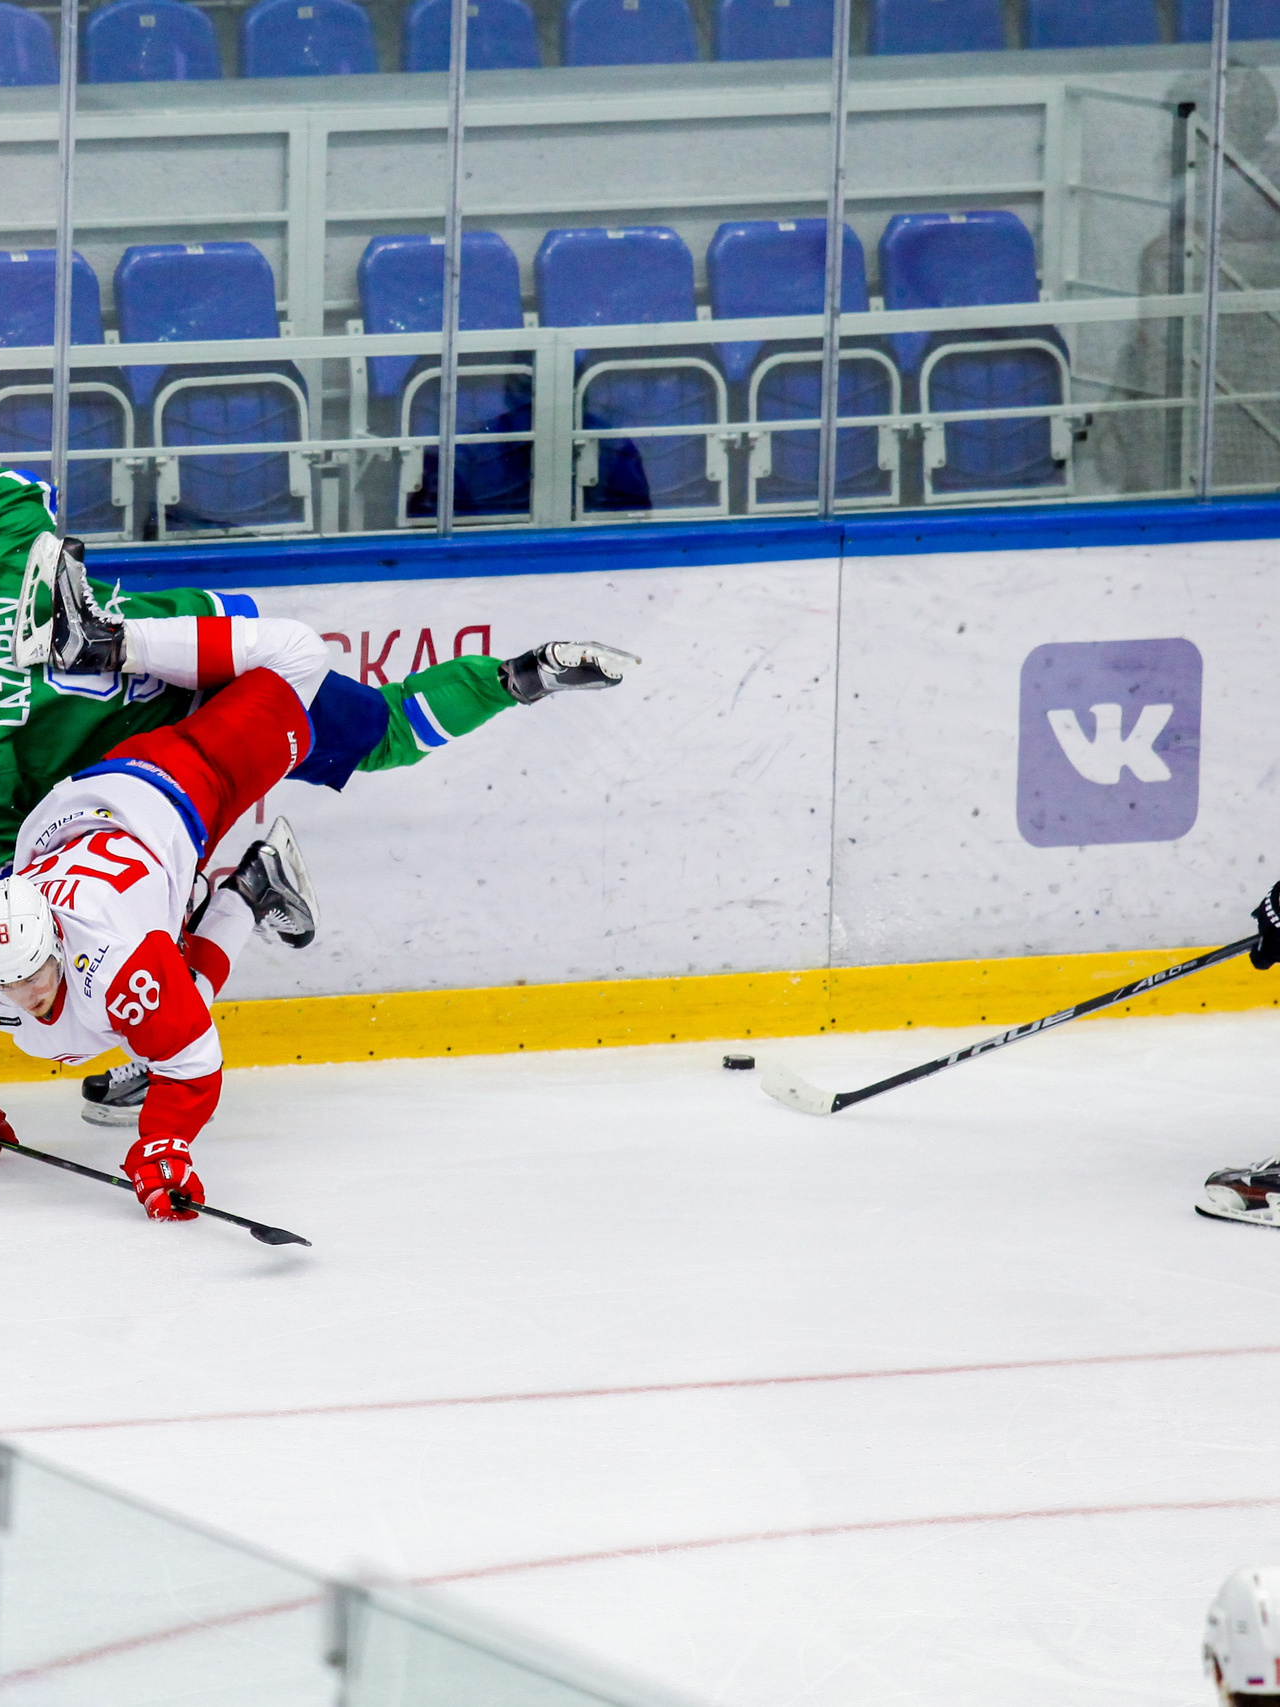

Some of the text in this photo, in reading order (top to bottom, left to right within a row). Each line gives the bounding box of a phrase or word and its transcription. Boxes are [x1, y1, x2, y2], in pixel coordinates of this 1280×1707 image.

[35, 811, 84, 847] ERIELL
[83, 944, 110, 999] ERIELL
[107, 968, 161, 1026] 58
[936, 1005, 1078, 1066] TRUE
[142, 1138, 189, 1157] CC
